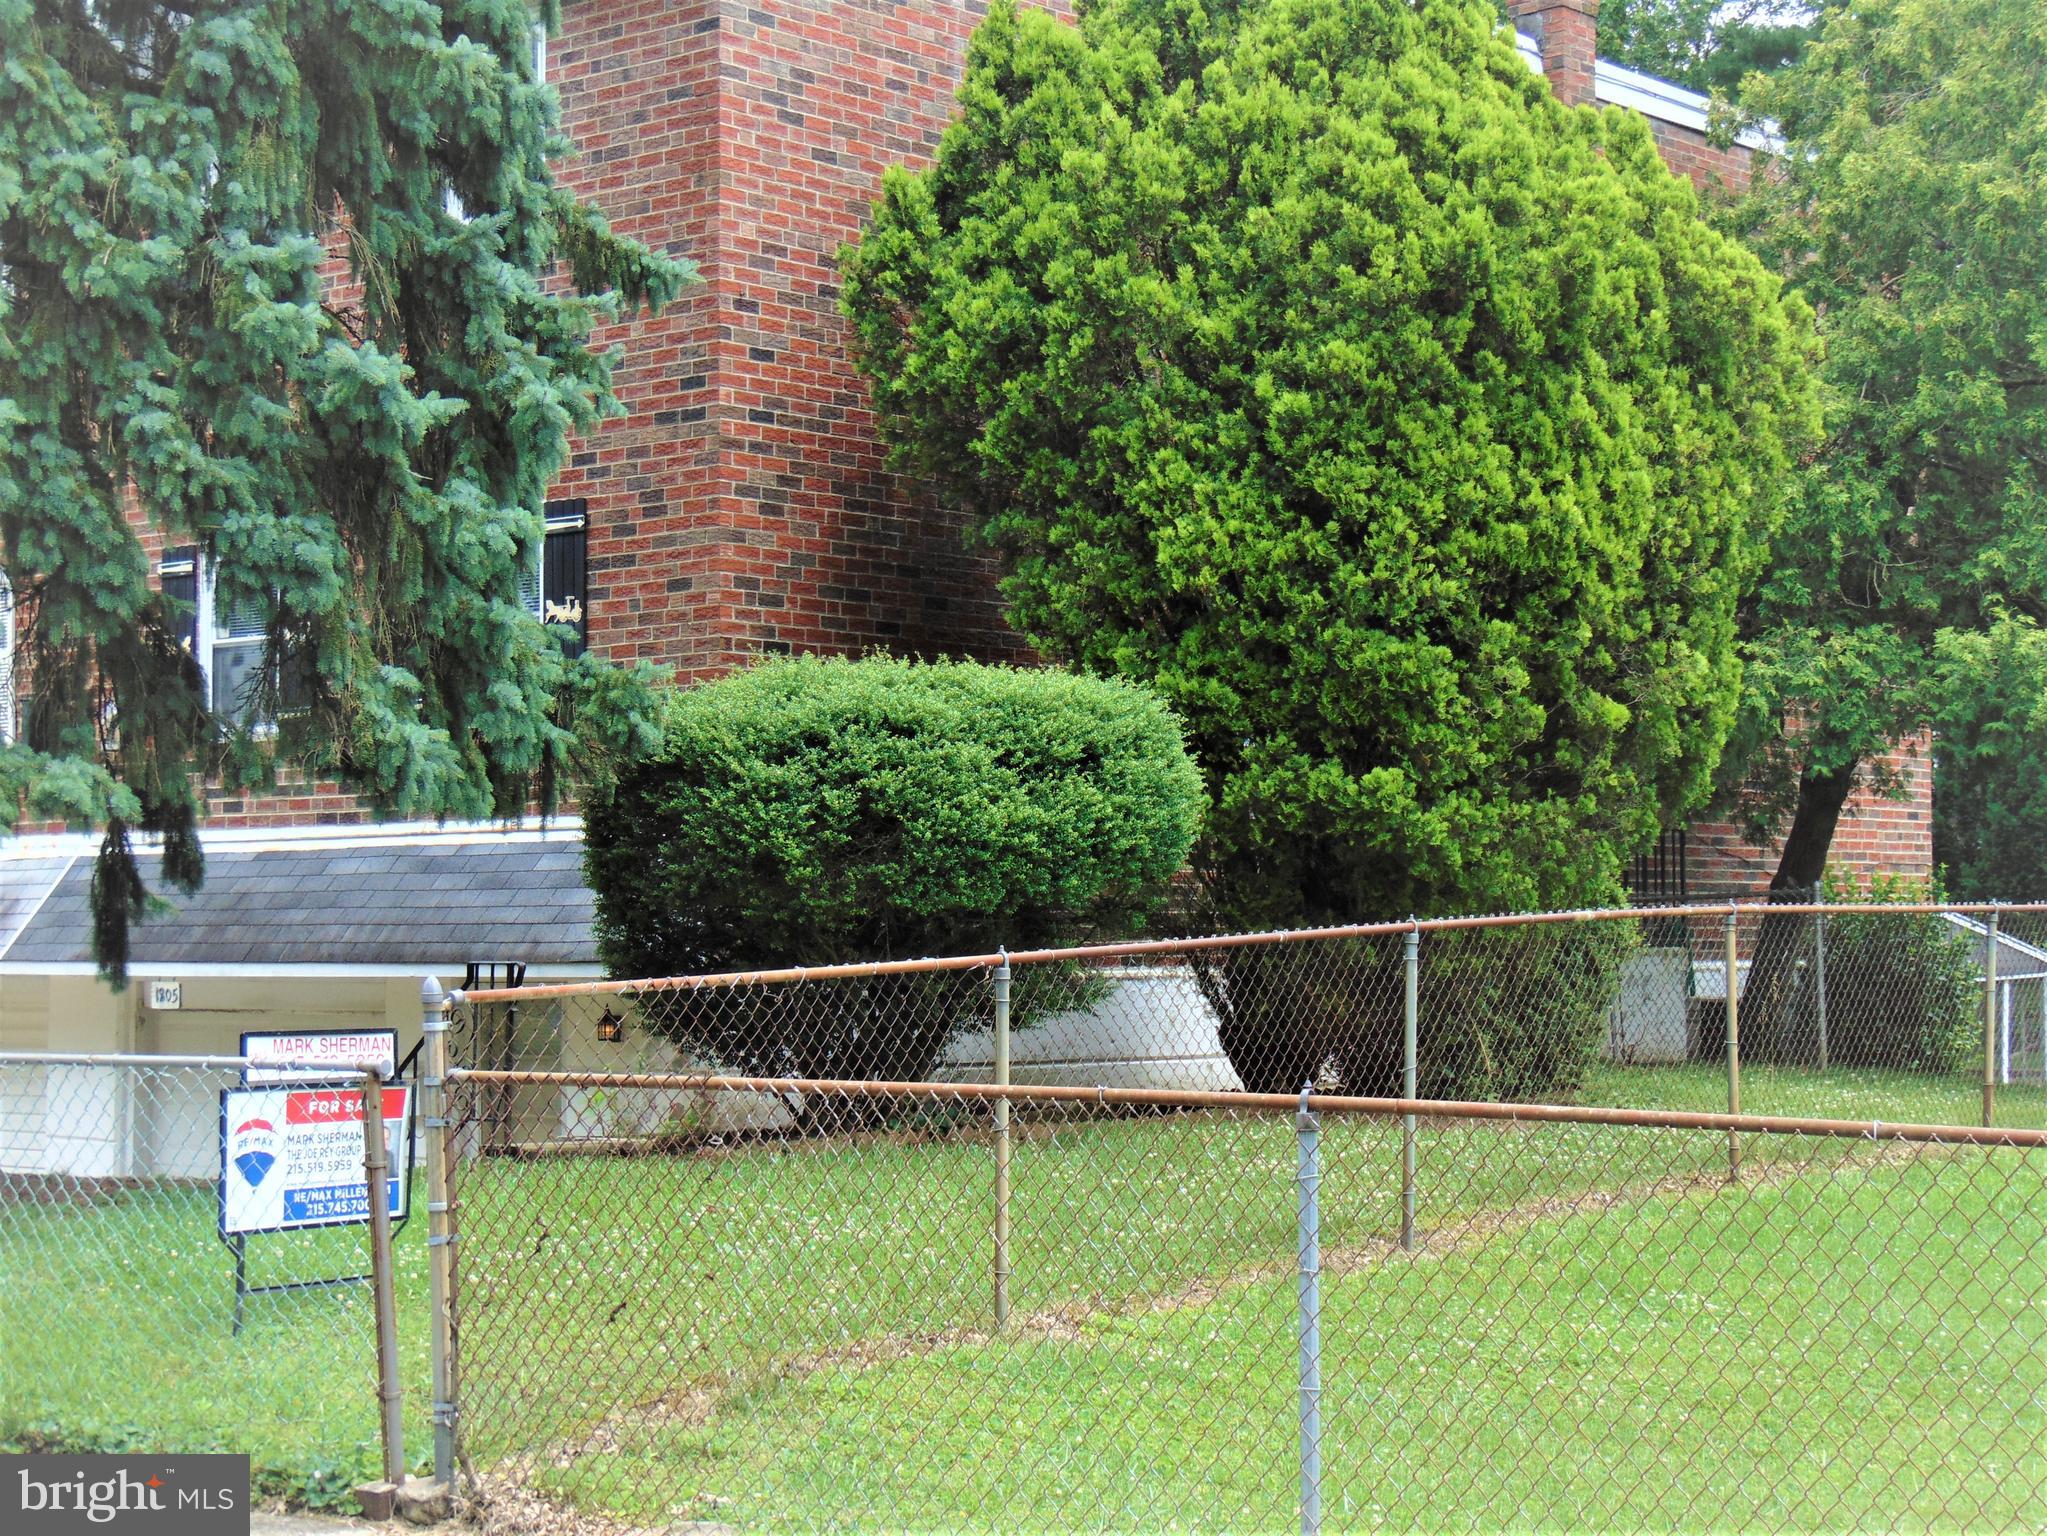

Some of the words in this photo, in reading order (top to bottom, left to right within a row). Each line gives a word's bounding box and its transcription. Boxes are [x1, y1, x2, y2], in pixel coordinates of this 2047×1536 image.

[156, 987, 178, 1003] 1805
[273, 1038, 313, 1054] MARK
[319, 1037, 391, 1053] SHERMAN
[308, 1101, 340, 1115] FOR
[287, 1133, 314, 1146] MARK
[317, 1131, 362, 1144] SHERMAN
[287, 1148, 302, 1161] THE
[287, 1159, 352, 1174] 215.519.5959
